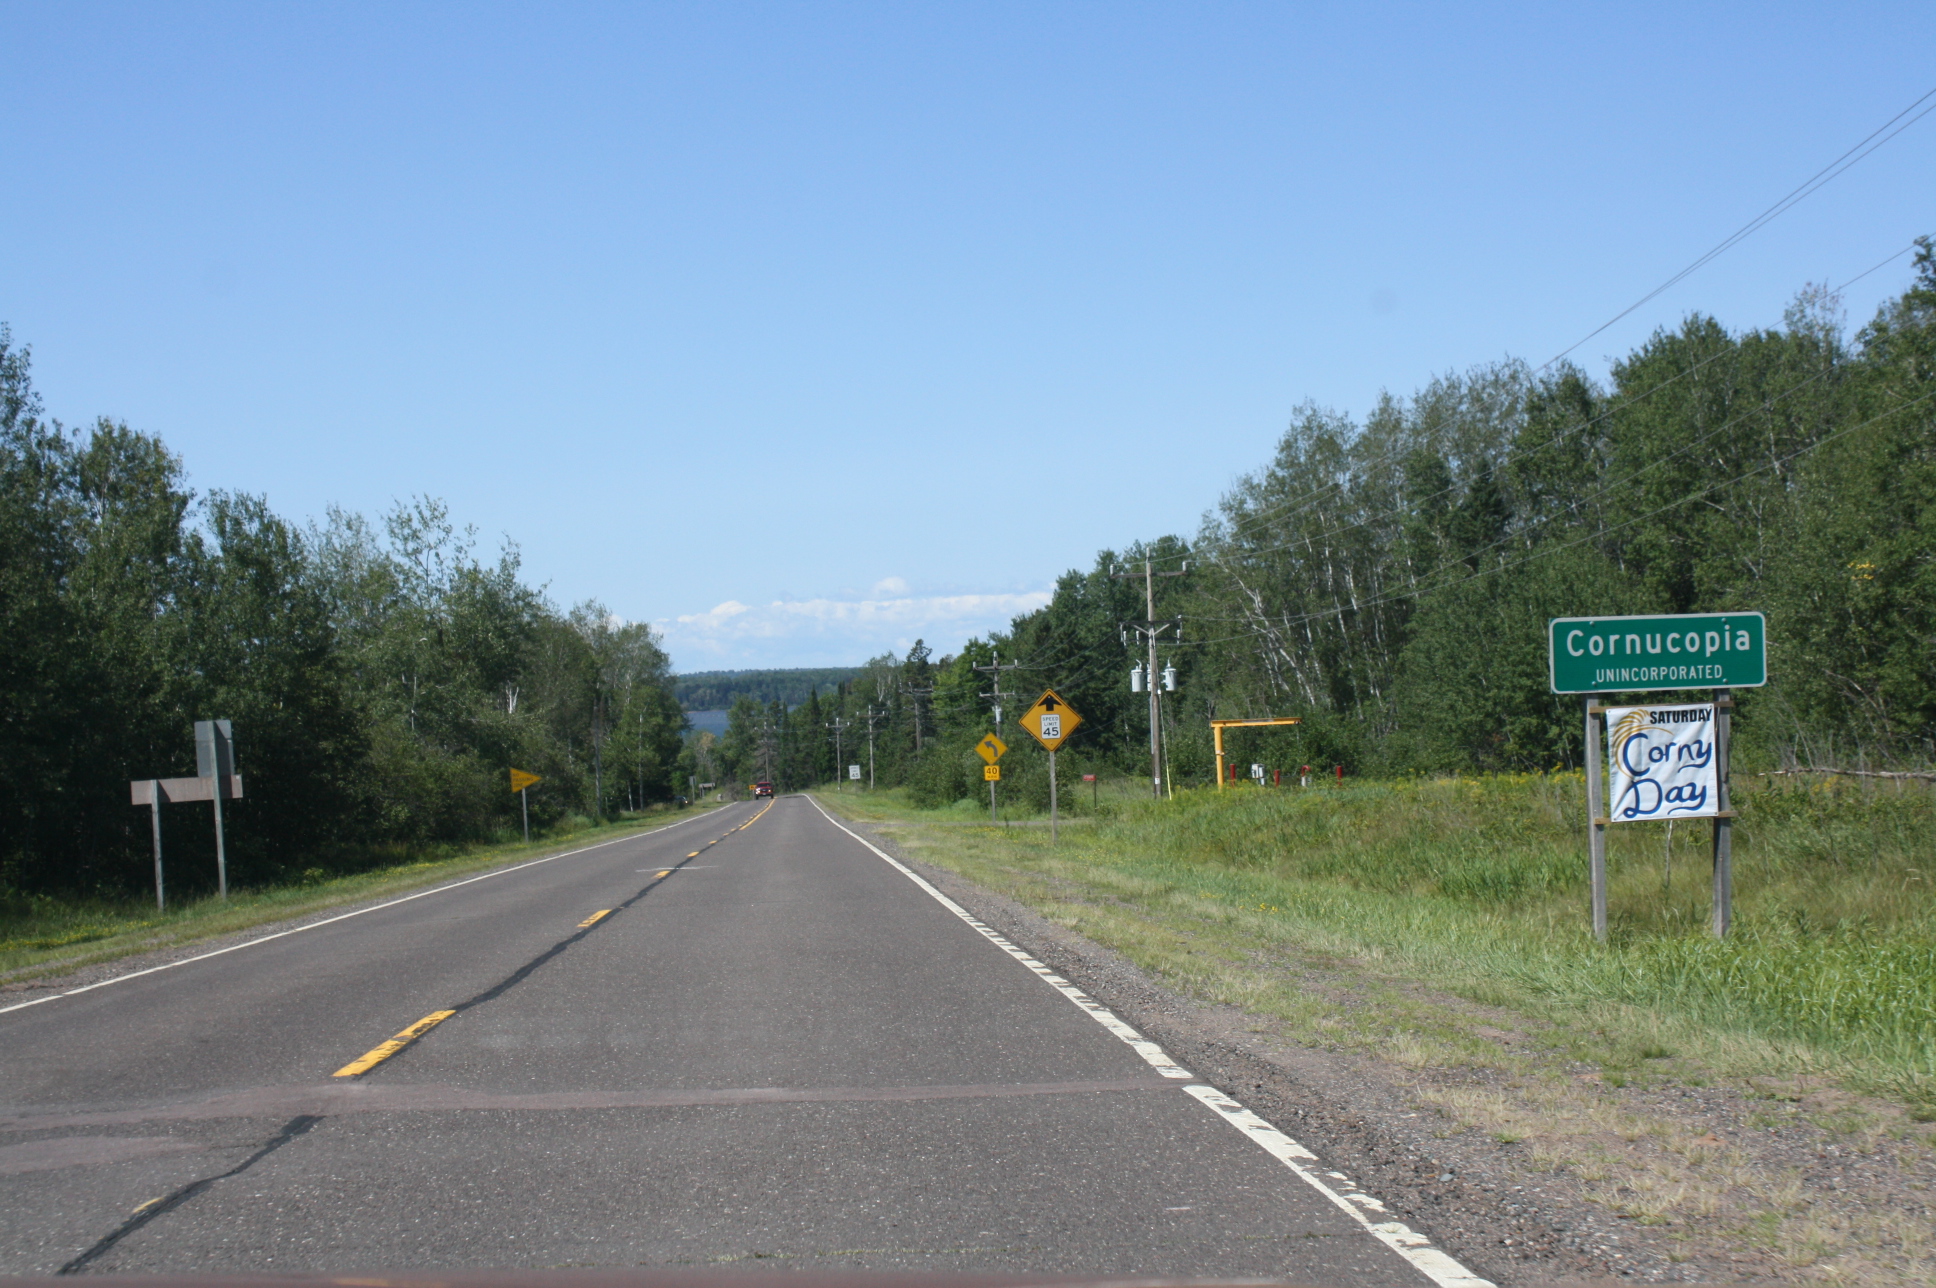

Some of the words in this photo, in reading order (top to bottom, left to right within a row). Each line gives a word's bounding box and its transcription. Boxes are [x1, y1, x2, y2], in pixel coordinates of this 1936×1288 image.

[1567, 625, 1750, 657] Cornucopia
[1596, 664, 1722, 683] UNINCORPORATED
[1650, 708, 1712, 724] SATURDAY
[1043, 727, 1059, 736] 45
[1623, 733, 1712, 777] Corny
[986, 767, 997, 775] 40
[1623, 778, 1707, 819] Day
